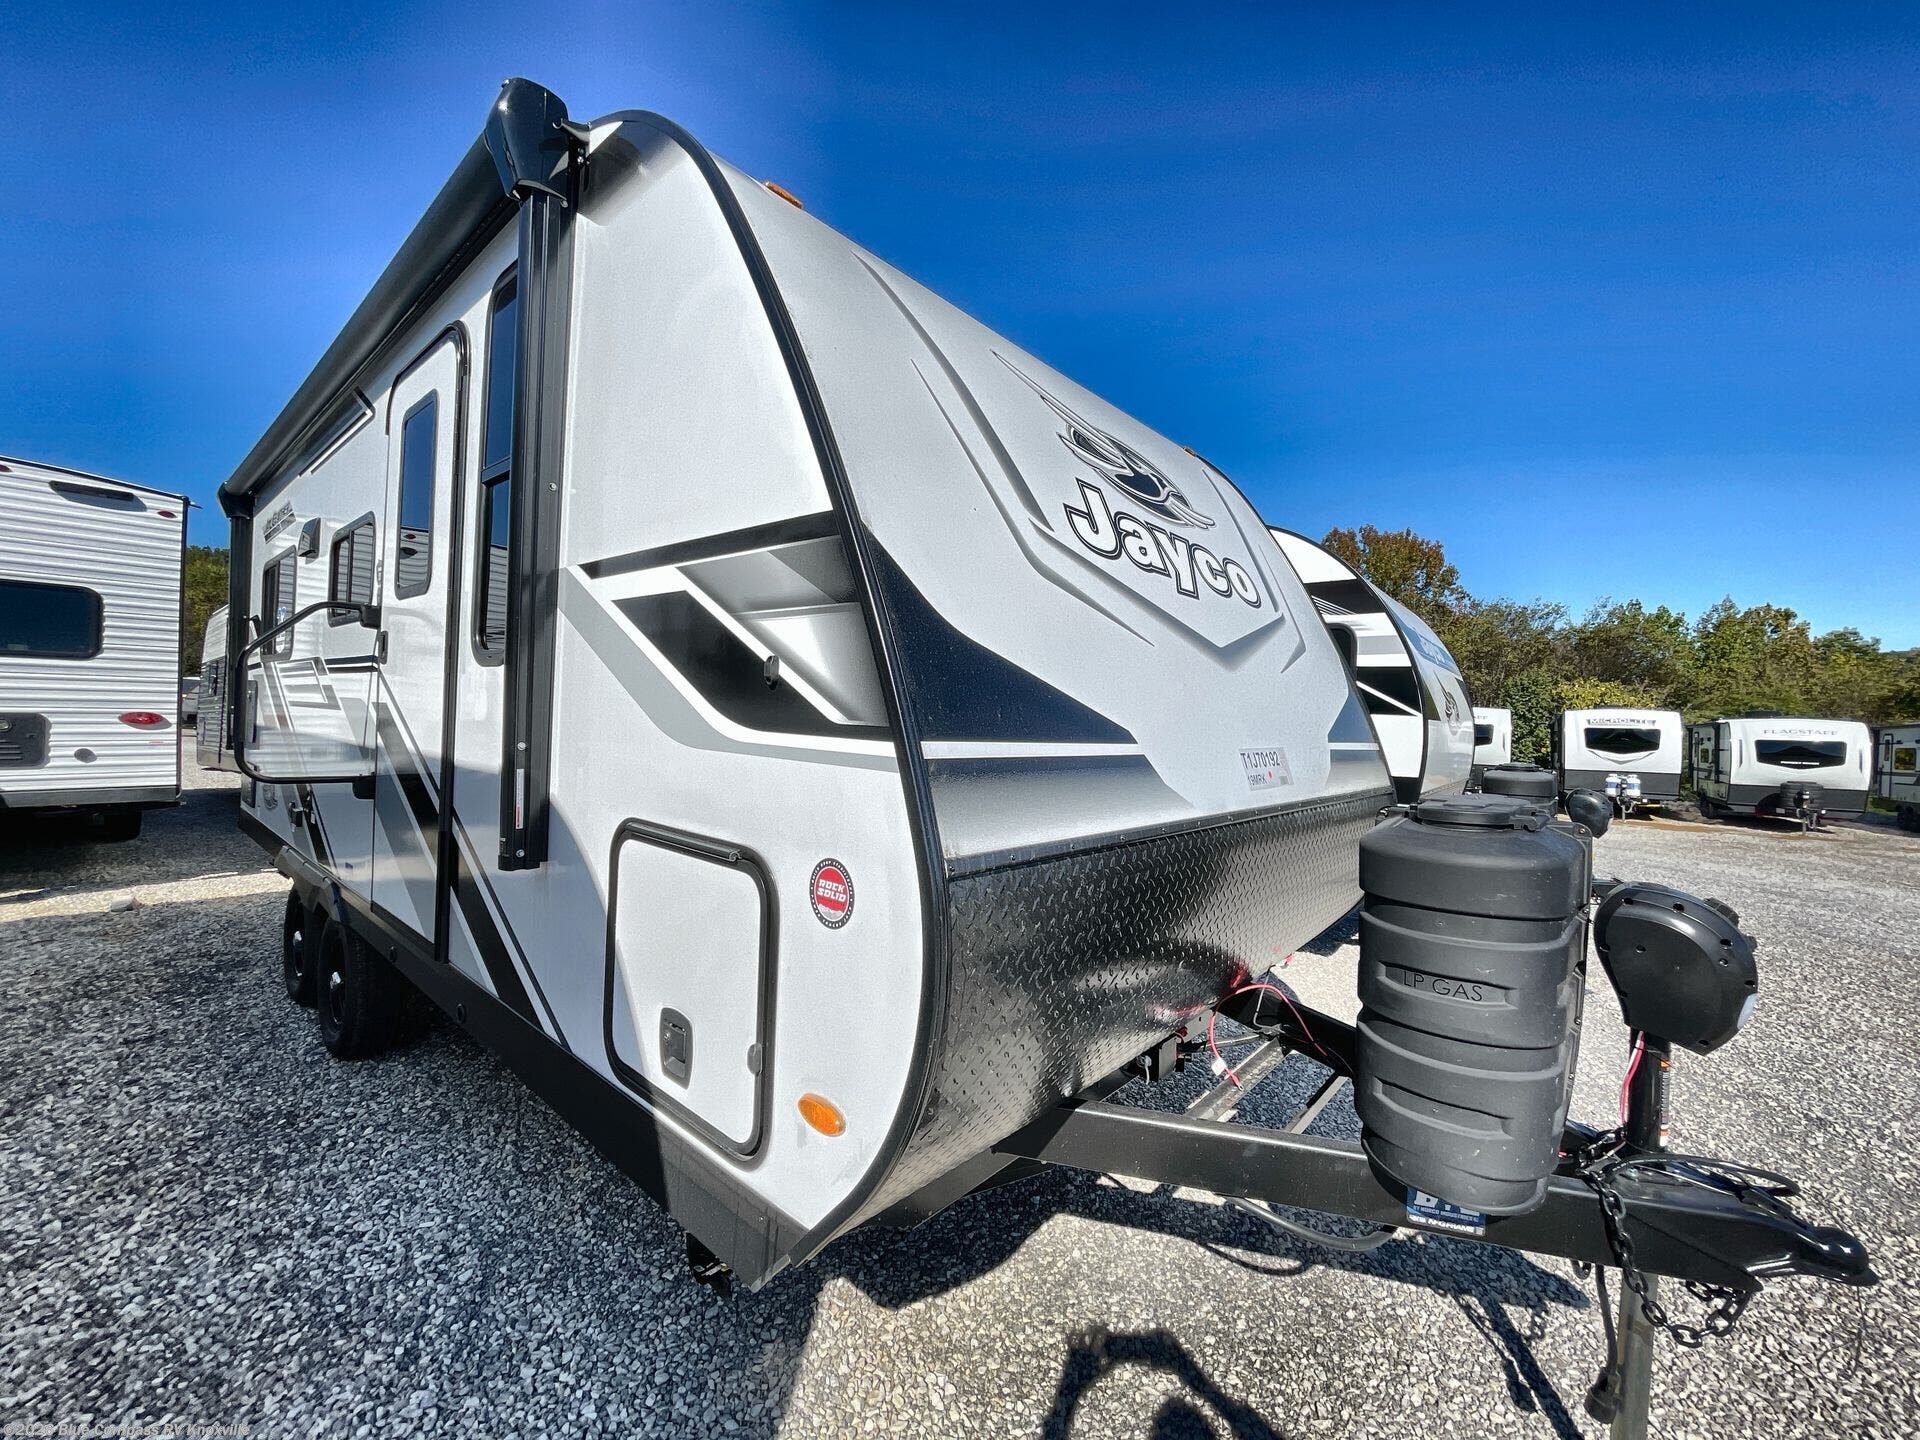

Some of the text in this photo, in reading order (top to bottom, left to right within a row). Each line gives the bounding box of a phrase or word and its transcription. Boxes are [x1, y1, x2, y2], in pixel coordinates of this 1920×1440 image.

[1063, 477, 1262, 609] Jayco
[1240, 751, 1280, 769] T1J70192
[817, 887, 847, 902] SOLID
[819, 879, 846, 893] ROCK
[1403, 970, 1483, 1002] LP GAS
